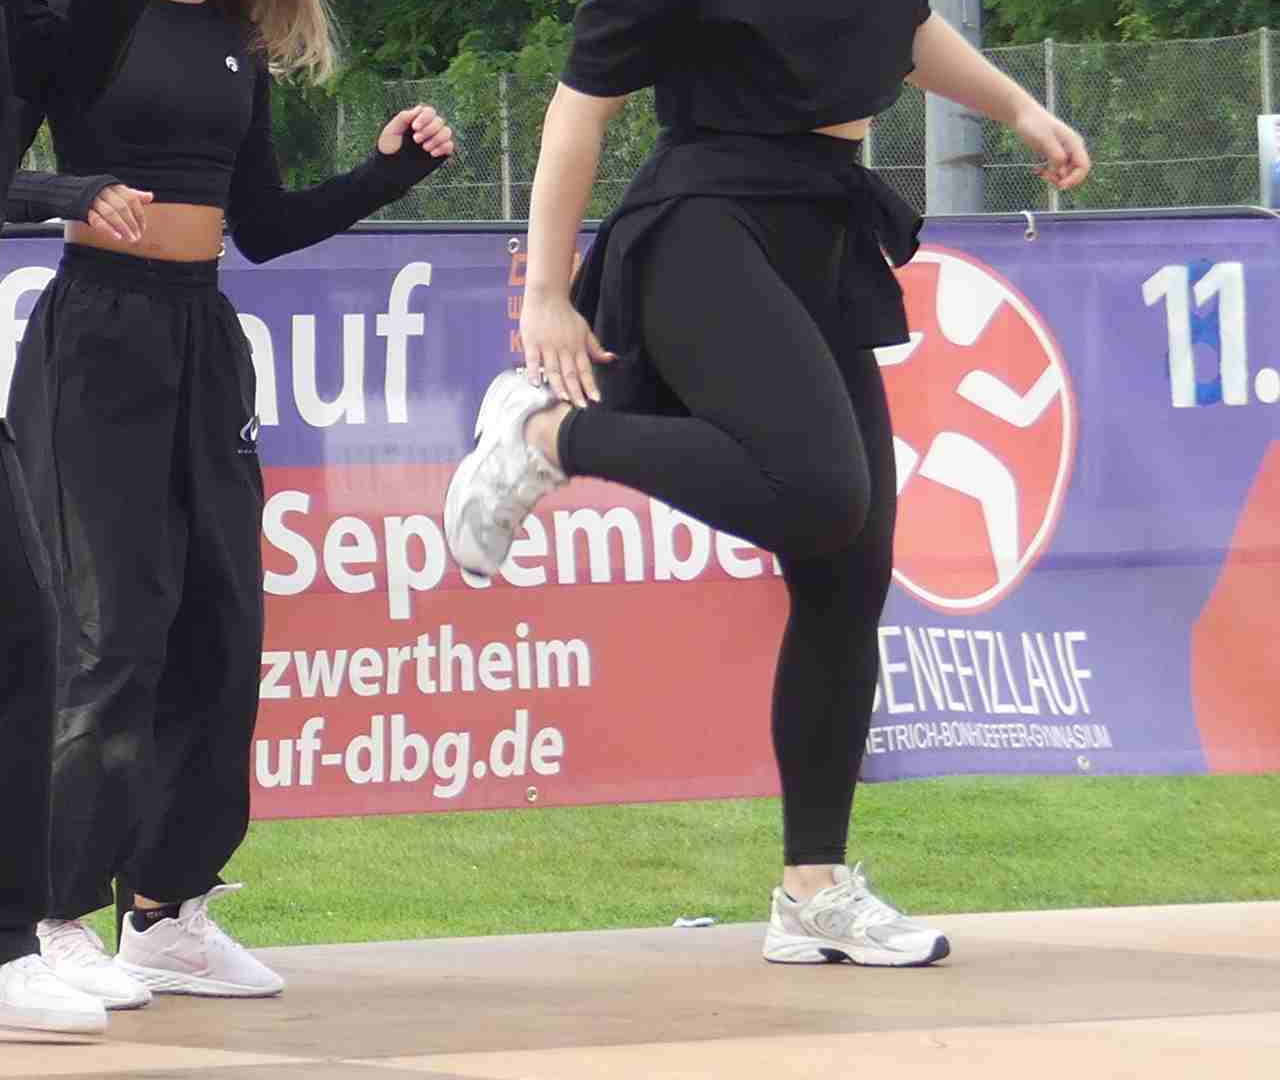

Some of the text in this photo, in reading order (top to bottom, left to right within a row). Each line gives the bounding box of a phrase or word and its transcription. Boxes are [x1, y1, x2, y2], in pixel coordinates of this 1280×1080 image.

[1141, 261, 1280, 408] 11.
[261, 490, 783, 620] Sepembe
[259, 622, 592, 699] zwertheim
[873, 626, 1092, 716] ENEFIZLAUF
